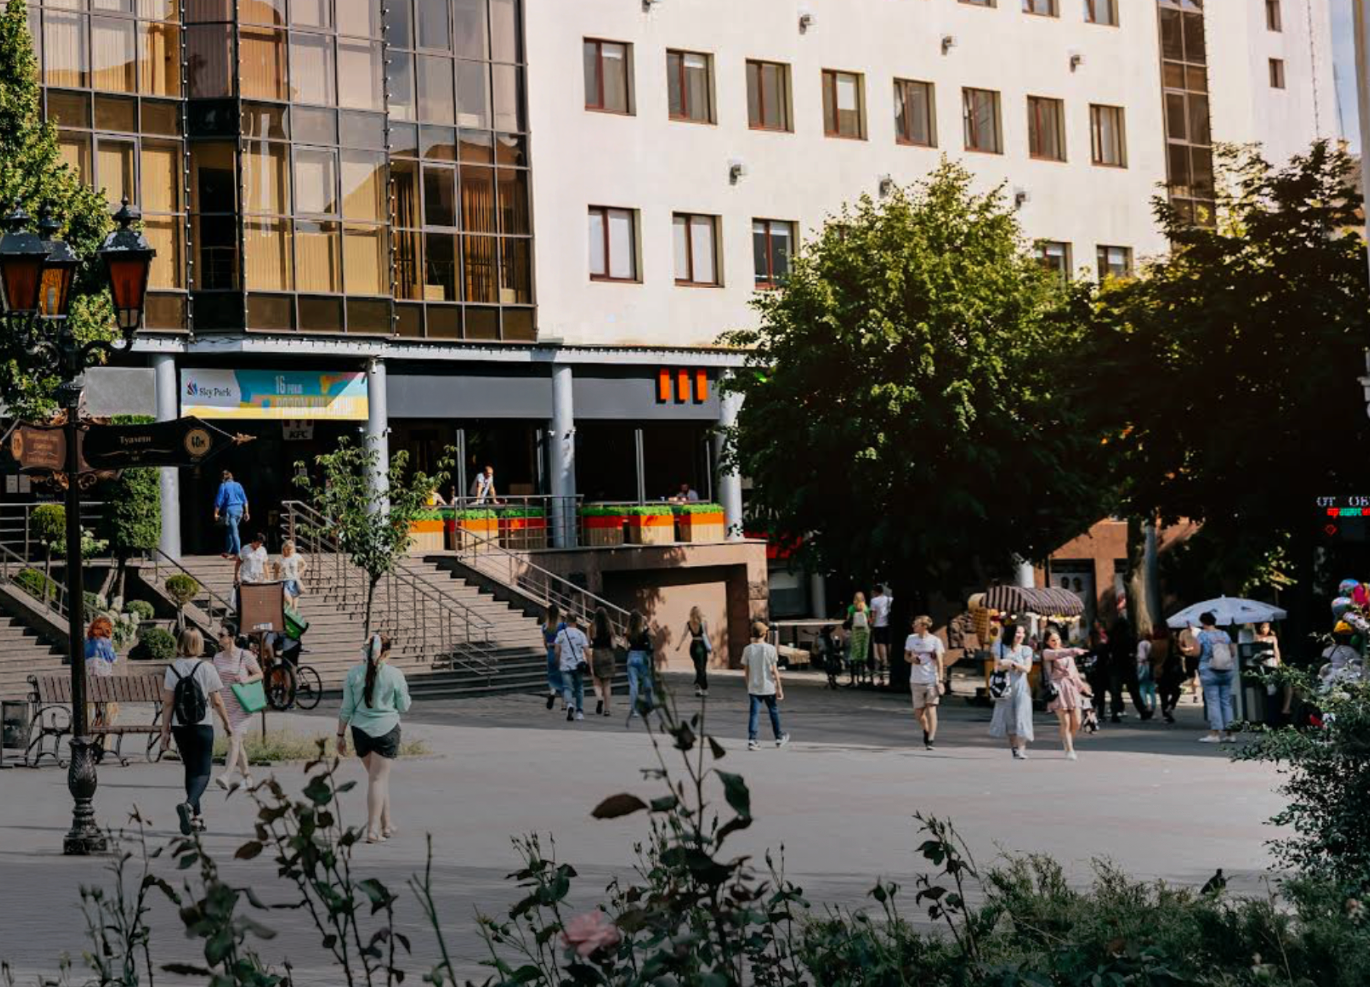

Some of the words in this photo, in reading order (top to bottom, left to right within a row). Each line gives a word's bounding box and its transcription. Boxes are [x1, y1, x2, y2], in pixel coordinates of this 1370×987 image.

[275, 375, 285, 394] 16
[199, 387, 213, 399] Sky
[214, 387, 231, 397] Park
[289, 430, 308, 439] KFC
